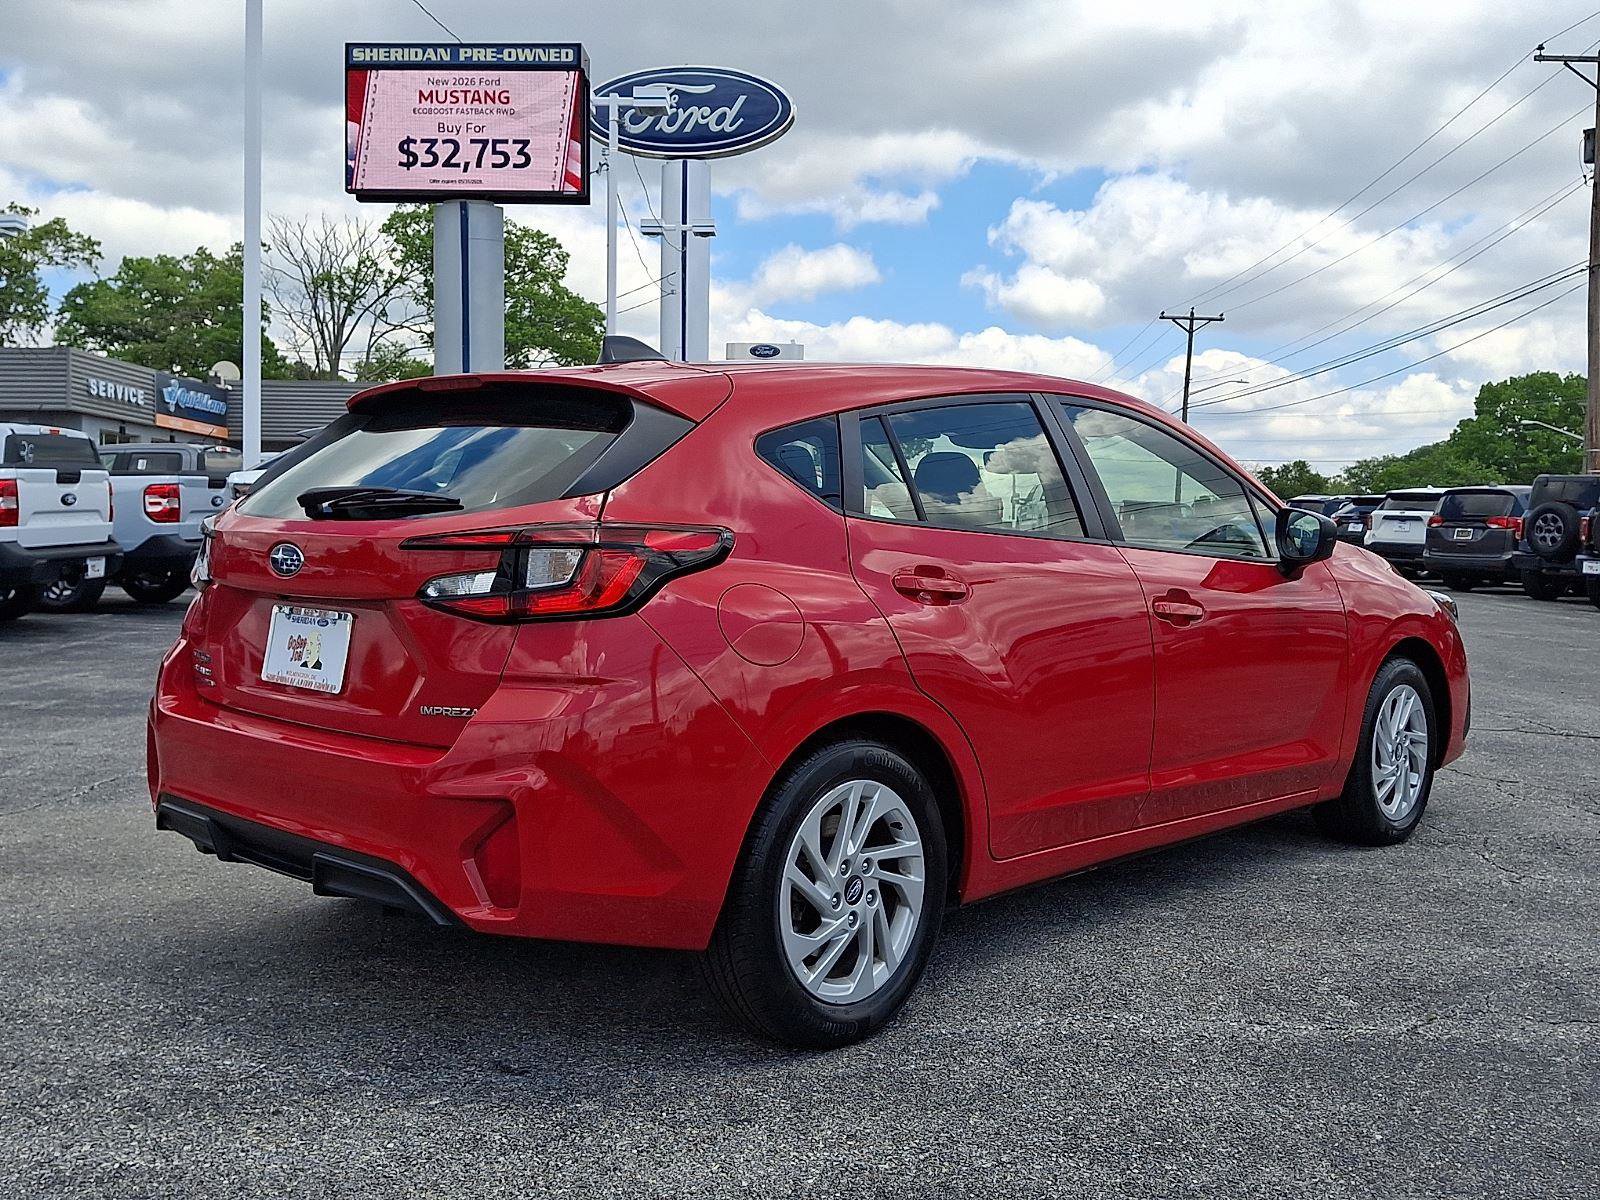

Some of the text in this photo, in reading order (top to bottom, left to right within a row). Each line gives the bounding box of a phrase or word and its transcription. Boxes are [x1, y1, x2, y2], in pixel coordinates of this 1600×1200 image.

[352, 48, 574, 63] SHERIDAN PRE-OWNED
[427, 77, 501, 86] New 2026 Ford
[418, 89, 511, 105] MUSTANG
[412, 107, 516, 116] ECOBOOST FASTBACK RWD
[437, 122, 486, 136] Buy For
[398, 135, 532, 173] $32,753
[755, 346, 775, 355] Ford
[89, 378, 145, 406] SERVICE
[291, 615, 317, 626] SHERIDAN
